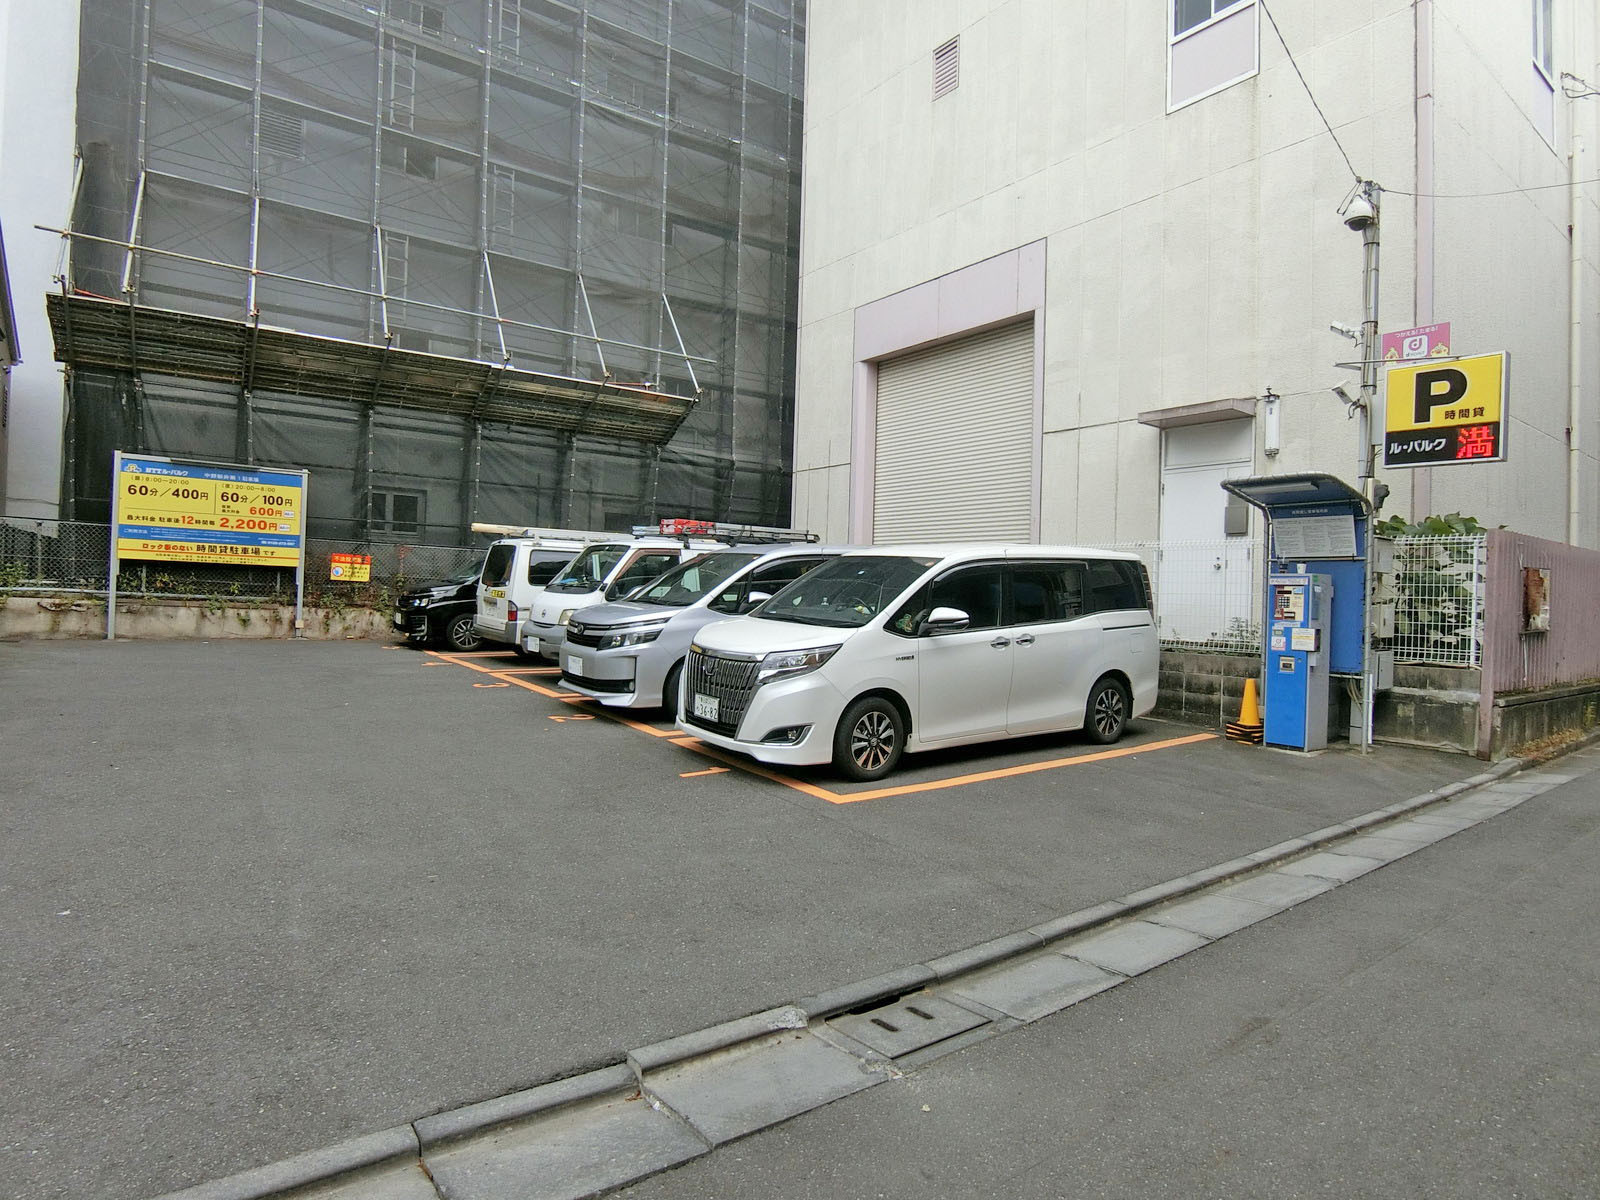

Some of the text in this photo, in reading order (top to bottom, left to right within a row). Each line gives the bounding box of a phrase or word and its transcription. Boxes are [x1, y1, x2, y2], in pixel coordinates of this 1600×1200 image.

[1414, 368, 1468, 424] P
[1444, 406, 1485, 420] 時間貸
[1456, 425, 1495, 459] 満
[249, 506, 283, 517] 600円
[196, 544, 261, 556] 時間貸駐車場
